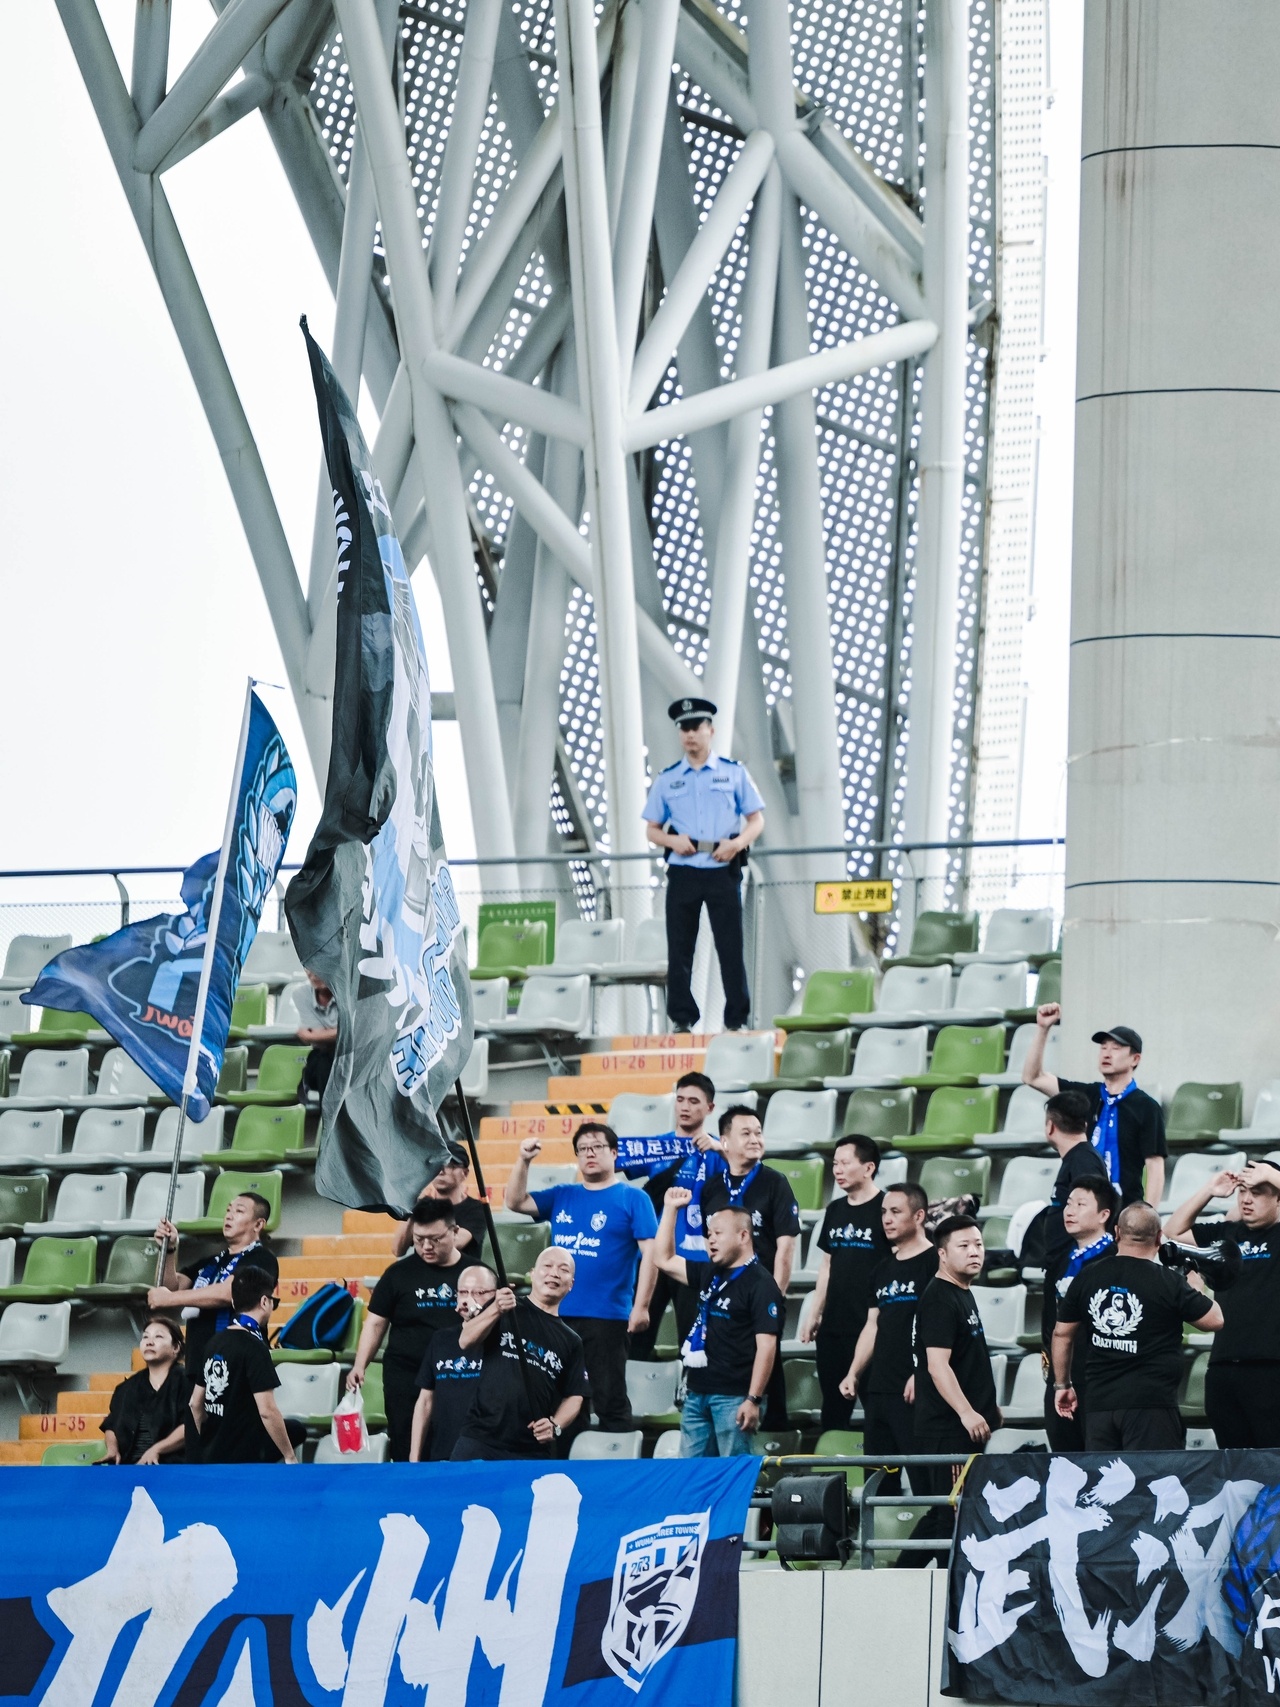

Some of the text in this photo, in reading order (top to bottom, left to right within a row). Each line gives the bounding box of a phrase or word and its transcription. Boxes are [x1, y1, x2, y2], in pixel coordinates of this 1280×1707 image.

[602, 1056, 645, 1070] 01-26
[502, 1120, 545, 1135] 01-26
[1092, 1333, 1138, 1354] CRAZY YOUTH
[41, 1416, 86, 1433] 01-35
